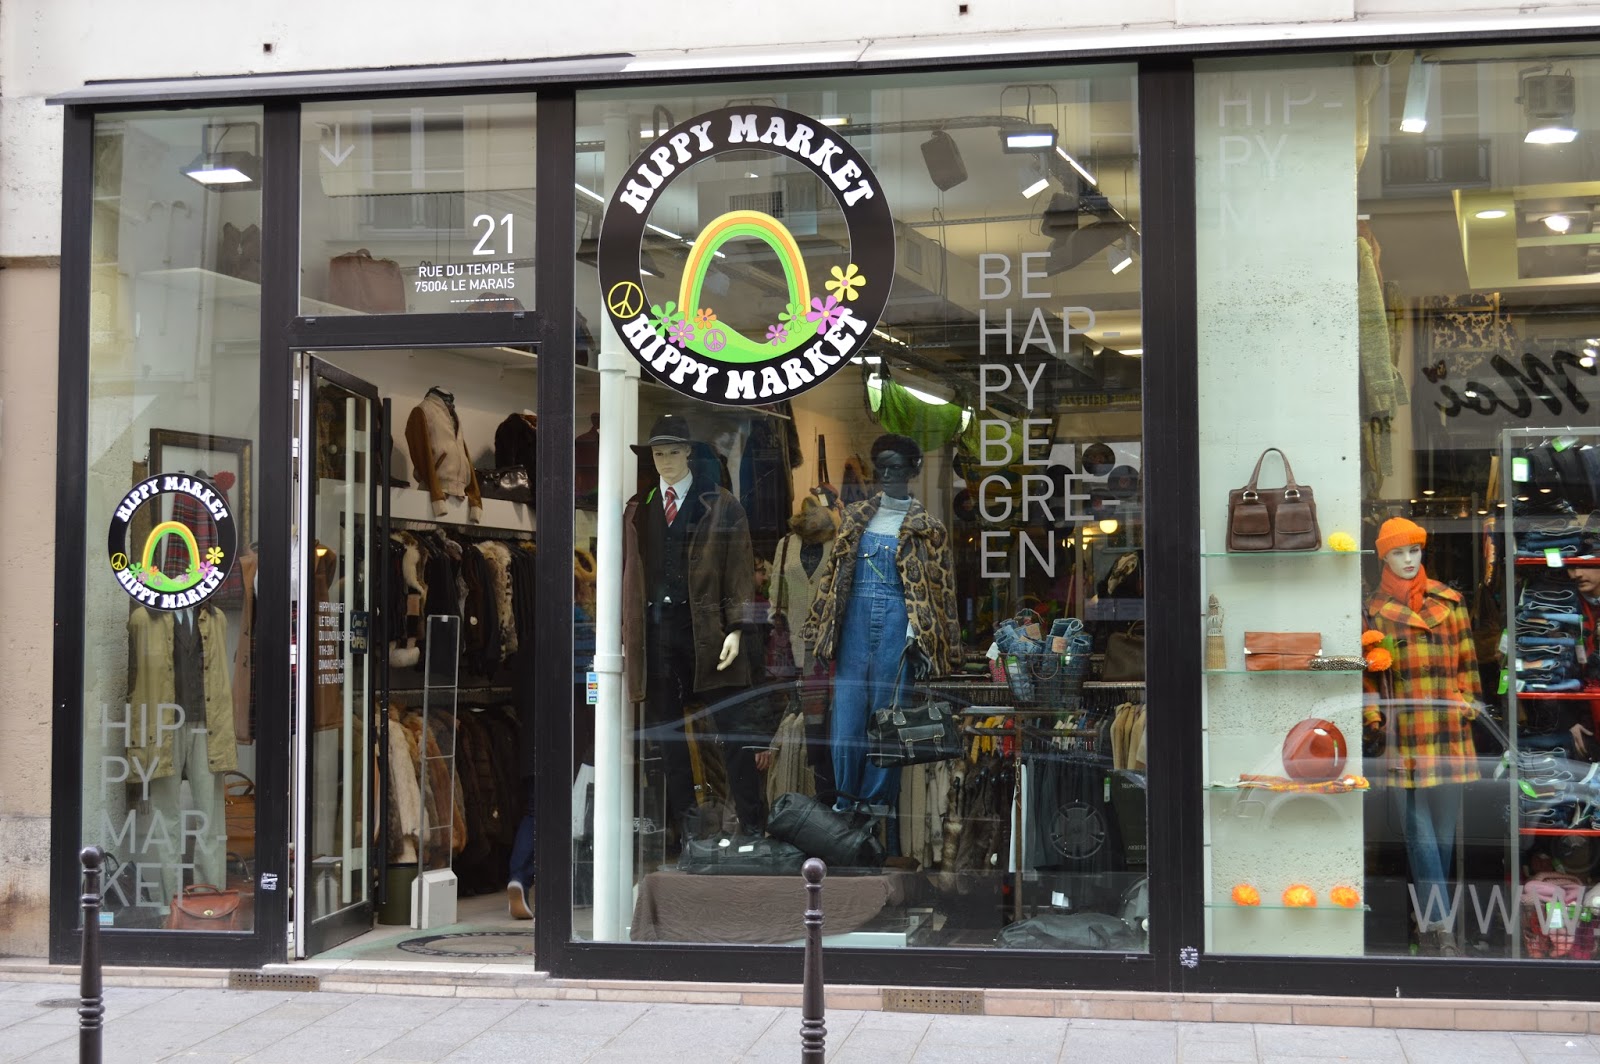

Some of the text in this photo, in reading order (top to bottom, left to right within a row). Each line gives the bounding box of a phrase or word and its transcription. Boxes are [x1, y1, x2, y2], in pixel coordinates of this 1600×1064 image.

[620, 114, 874, 214] HIPPY MARKET
[473, 213, 514, 256] 21
[415, 278, 515, 293] 75004 LE MARAIS
[418, 262, 515, 278] RUE DU TEMPLE
[979, 251, 1052, 300] BE
[622, 308, 868, 399] HIPPY MARKET
[979, 306, 1121, 355] HAP-
[979, 362, 1046, 411] PY
[979, 418, 1053, 466] BE
[116, 476, 229, 522] HIPPY MARKET
[978, 474, 1121, 522] GRE-
[980, 531, 1055, 579] EN
[116, 566, 224, 608] HIPPY MARKET
[102, 755, 160, 800] PY
[101, 862, 195, 908] KET
